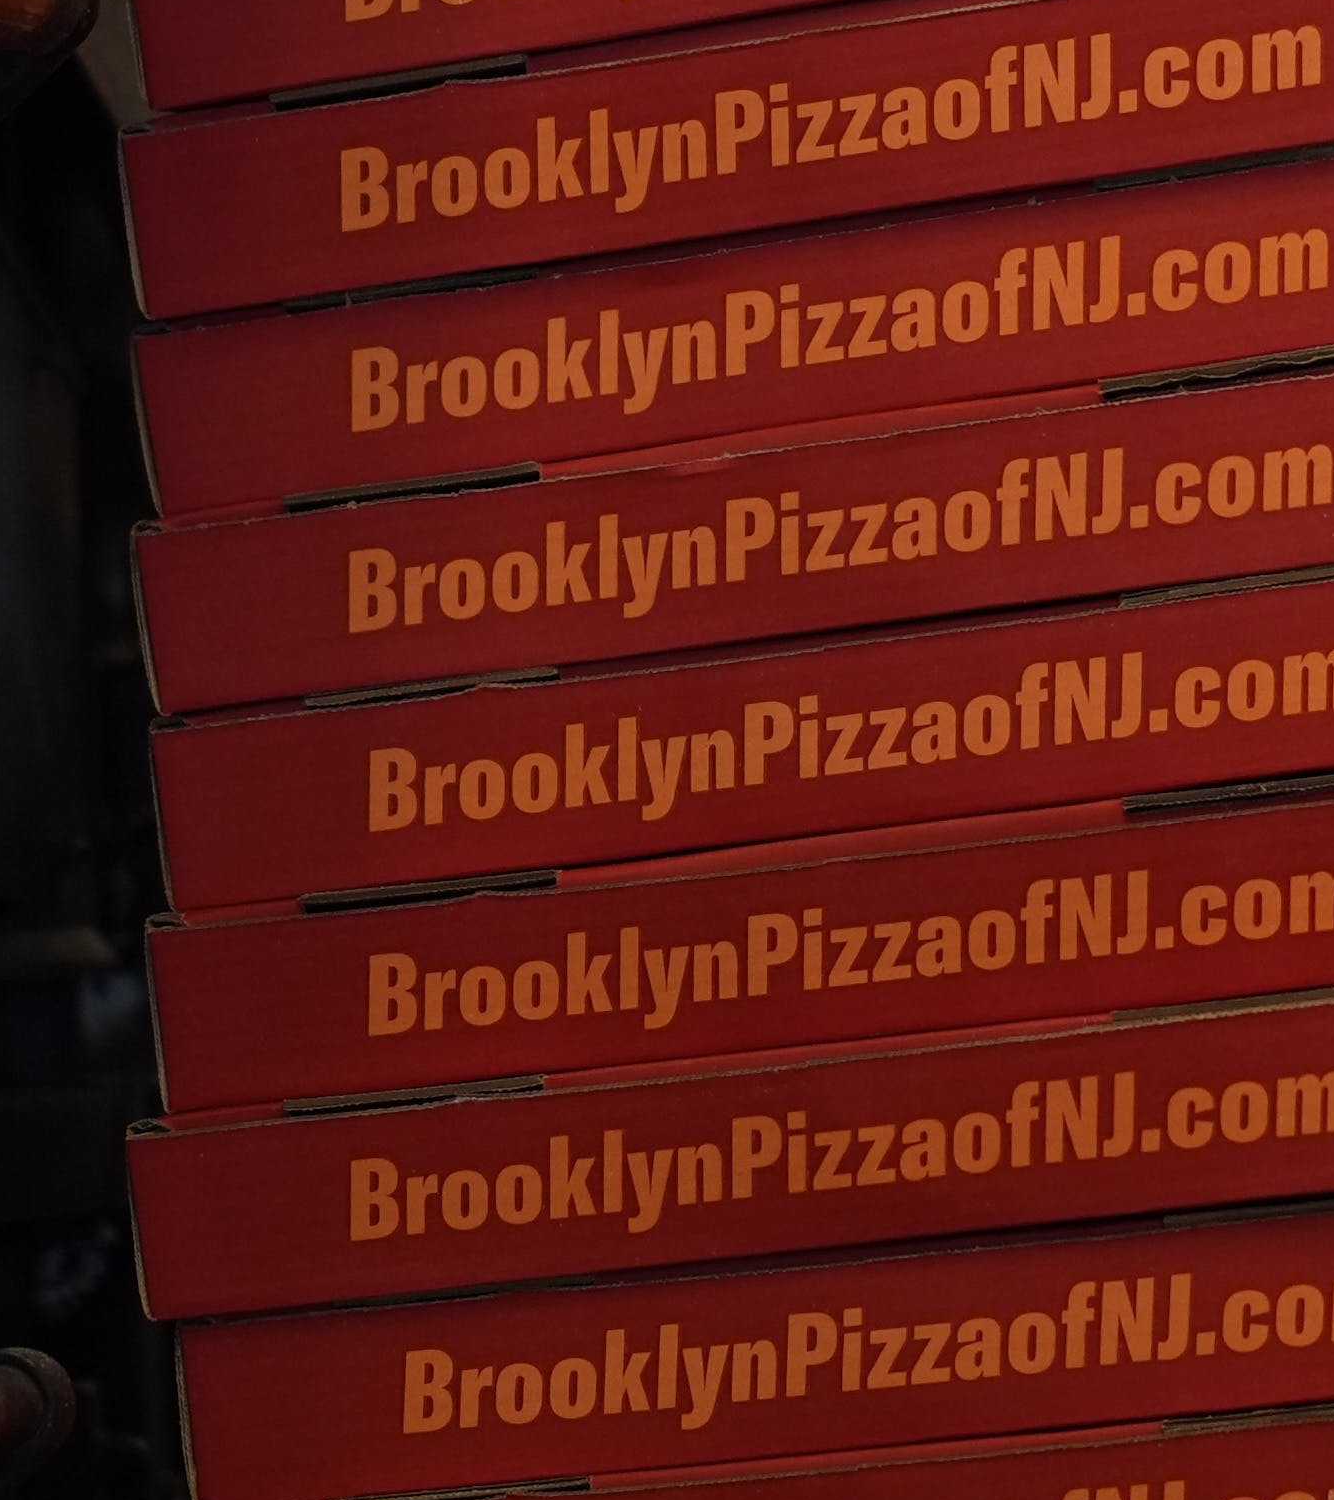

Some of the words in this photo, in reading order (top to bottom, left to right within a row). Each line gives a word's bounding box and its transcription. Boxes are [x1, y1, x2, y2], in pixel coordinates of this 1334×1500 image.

[341, 24, 1321, 231] BrooklynPizzaofNJ.com
[350, 226, 1330, 431] BrooklynPizzaofNJ.com
[349, 445, 1334, 631] BrooklynPizzaofNJ.com
